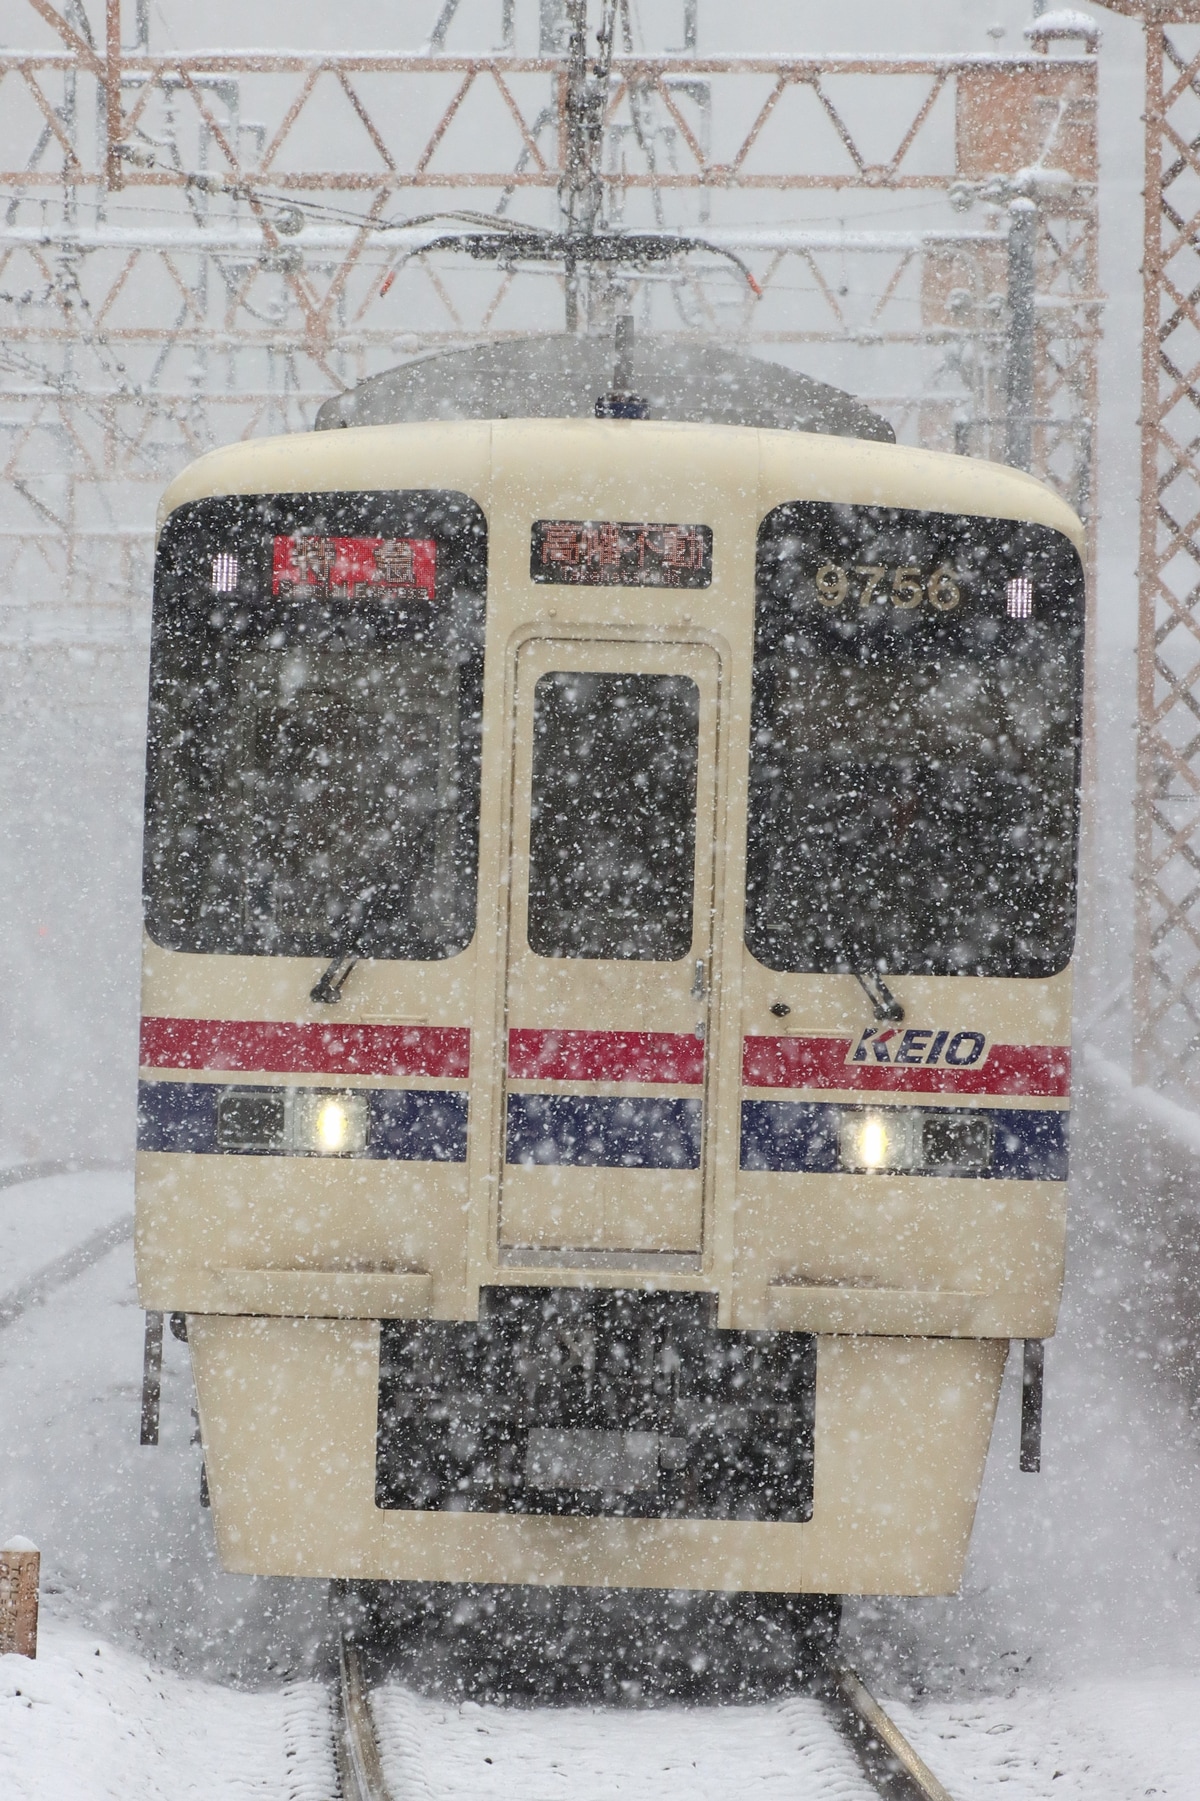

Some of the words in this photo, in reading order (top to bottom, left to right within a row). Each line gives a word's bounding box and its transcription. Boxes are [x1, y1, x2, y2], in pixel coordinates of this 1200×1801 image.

[290, 536, 416, 584] 特急
[280, 579, 349, 600] Special
[815, 563, 961, 611] 9756
[852, 1028, 986, 1066] KEIO
